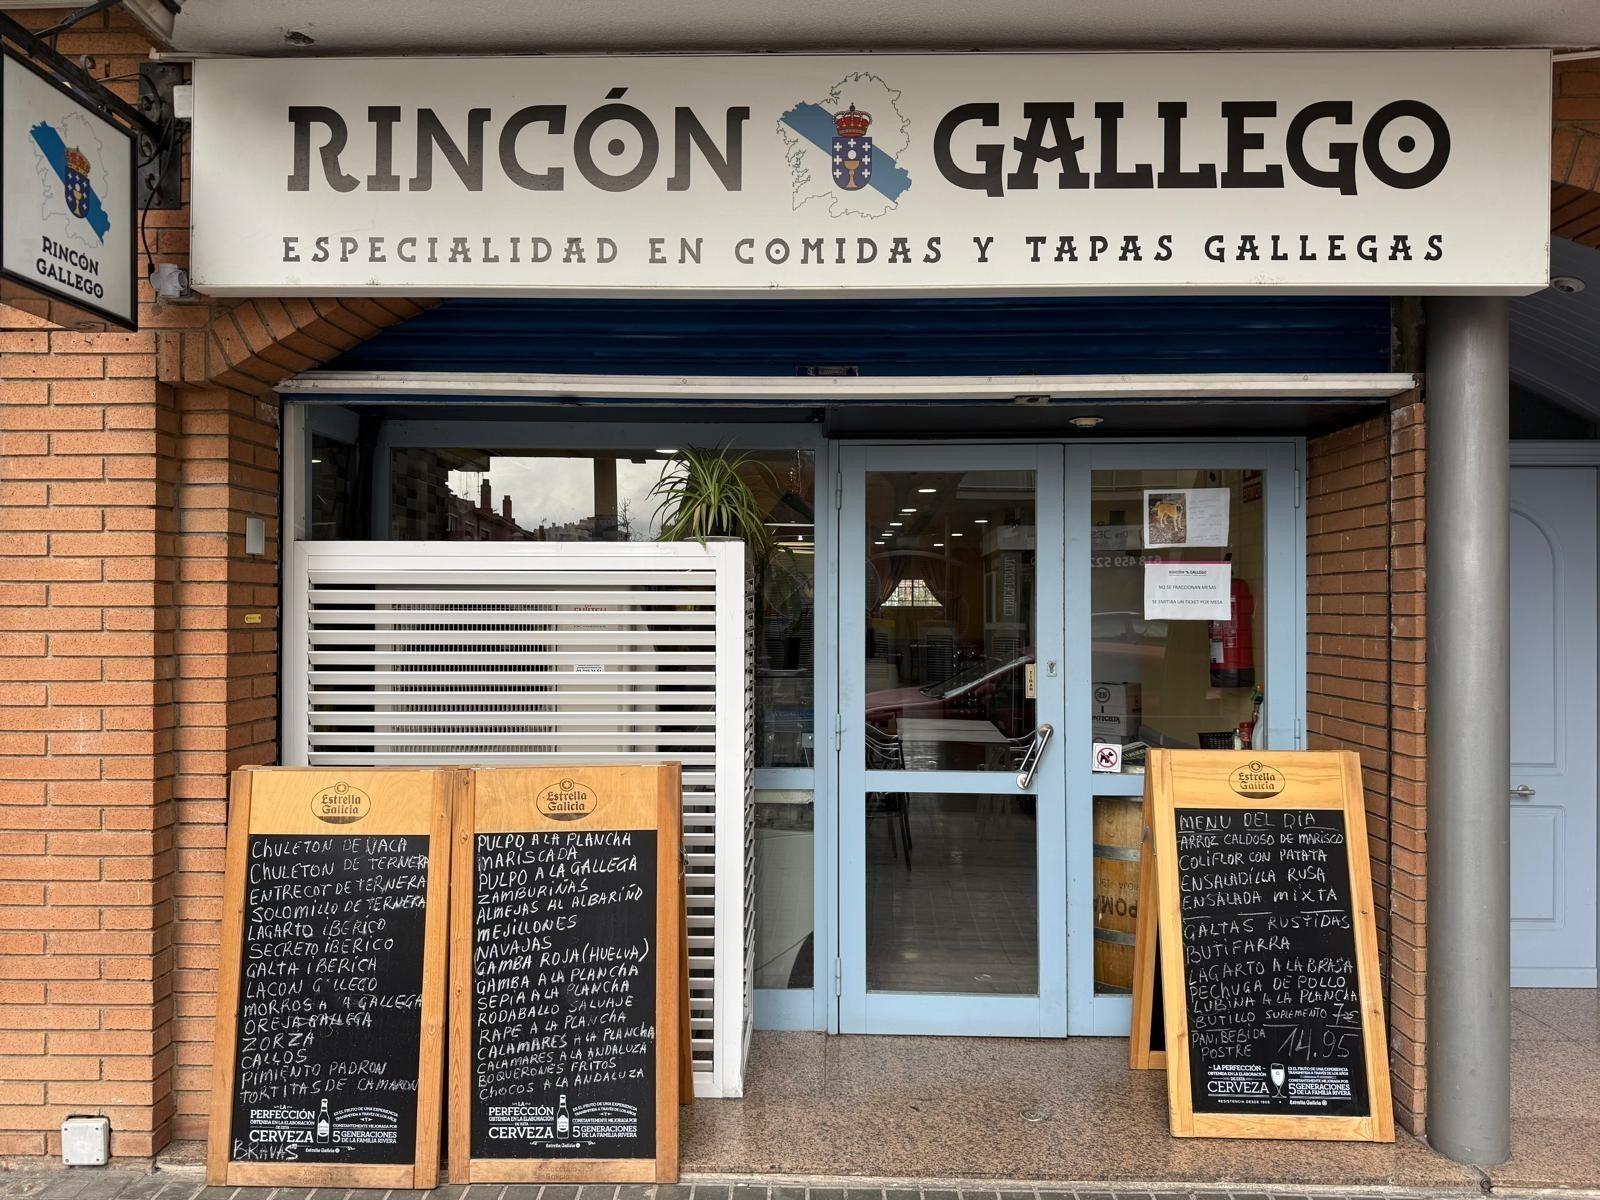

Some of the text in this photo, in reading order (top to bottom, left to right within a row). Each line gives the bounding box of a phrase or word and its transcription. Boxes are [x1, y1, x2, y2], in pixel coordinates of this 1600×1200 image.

[287, 87, 1451, 197] RINCÓN GALLEGO
[42, 236, 99, 276] RINCÓN
[283, 234, 1443, 264] ESPECIALIDAD EN COMIDAS Y TAPAS GALLEGAS
[36, 258, 104, 298] GALLEGO
[1239, 773, 1275, 781] Estrella
[1240, 781, 1275, 790] Galicia
[321, 795, 361, 805] Estrella
[547, 792, 587, 801] Estrella
[322, 805, 358, 815] Galicia
[548, 801, 585, 811] Galicia
[1180, 815, 1231, 831] MENU
[1244, 812, 1275, 827] DEL
[343, 839, 362, 852] DE
[366, 837, 408, 855] VACA
[478, 835, 525, 852] PULPO
[532, 834, 539, 846] A
[544, 834, 559, 846] LA
[1180, 835, 1219, 850] ARROZ
[1224, 834, 1275, 845] CALDOSO
[1280, 834, 1294, 844] DE
[344, 859, 360, 871] DE
[1249, 851, 1271, 863] CON
[1280, 850, 1327, 863] PATATA
[479, 855, 637, 892] PULPO A LA GALLEGA
[1288, 866, 1326, 882] RUSA
[250, 875, 426, 905] ENTRECOT DE TERNERA
[344, 900, 360, 912] DE
[367, 895, 426, 911] TERNERA
[1182, 891, 1262, 911] ENSALADA
[477, 902, 539, 925] ALMEJAS
[548, 900, 563, 911] AL
[248, 922, 313, 941] LAGARTO
[1184, 919, 1254, 941] GALTAS
[249, 942, 318, 958] SECRETO
[476, 936, 552, 961] NAVAJAS
[247, 961, 299, 978] GALTA
[475, 955, 532, 976] GAMBA
[1189, 958, 1353, 986] LAGARTO A LA BRASA
[247, 980, 302, 998] LACON
[476, 976, 530, 995] GAMBA
[538, 973, 546, 986] A
[551, 970, 564, 983] LA
[1273, 976, 1291, 990] DE
[1298, 976, 1346, 989] POLLO
[532, 988, 540, 1001] A
[545, 986, 559, 999] LA
[1263, 994, 1271, 1005] A
[1276, 993, 1291, 1004] LA
[244, 998, 312, 1018] MORROS
[478, 995, 633, 1027] RODABALLO SALVAJE
[1265, 1008, 1327, 1019] SUPLEMENTO
[245, 1016, 300, 1034] OREJA
[480, 1024, 522, 1045] RAPE
[530, 1022, 538, 1034] A
[545, 1018, 558, 1031] LA
[242, 1032, 314, 1052] ZORZA
[478, 1034, 568, 1060] CALAMARES
[574, 1035, 581, 1045] A
[585, 1031, 596, 1042] LA
[1278, 1028, 1359, 1061] 14.95
[242, 1049, 307, 1069] CALLOS
[477, 1042, 647, 1074] CALAMARES A LA ANDALUZA
[1202, 1044, 1252, 1061] POSTRE
[242, 1060, 387, 1089] PIMIENTO PADRON
[479, 1057, 617, 1087] BOQUERONES FRITOS
[544, 1079, 551, 1090] A
[556, 1076, 568, 1087] LA
[574, 1069, 644, 1087] ANDALUZA
[240, 1081, 321, 1104] TORTITAS
[325, 1079, 347, 1092] DE
[1208, 1081, 1296, 1095] CERVEZA 5
[250, 1109, 315, 1119] PERFECCIÓN
[489, 1105, 554, 1116] PERFECCIÓN
[250, 1130, 340, 1143] CERVEZA 5
[489, 1126, 580, 1138] CERVEZA 5
